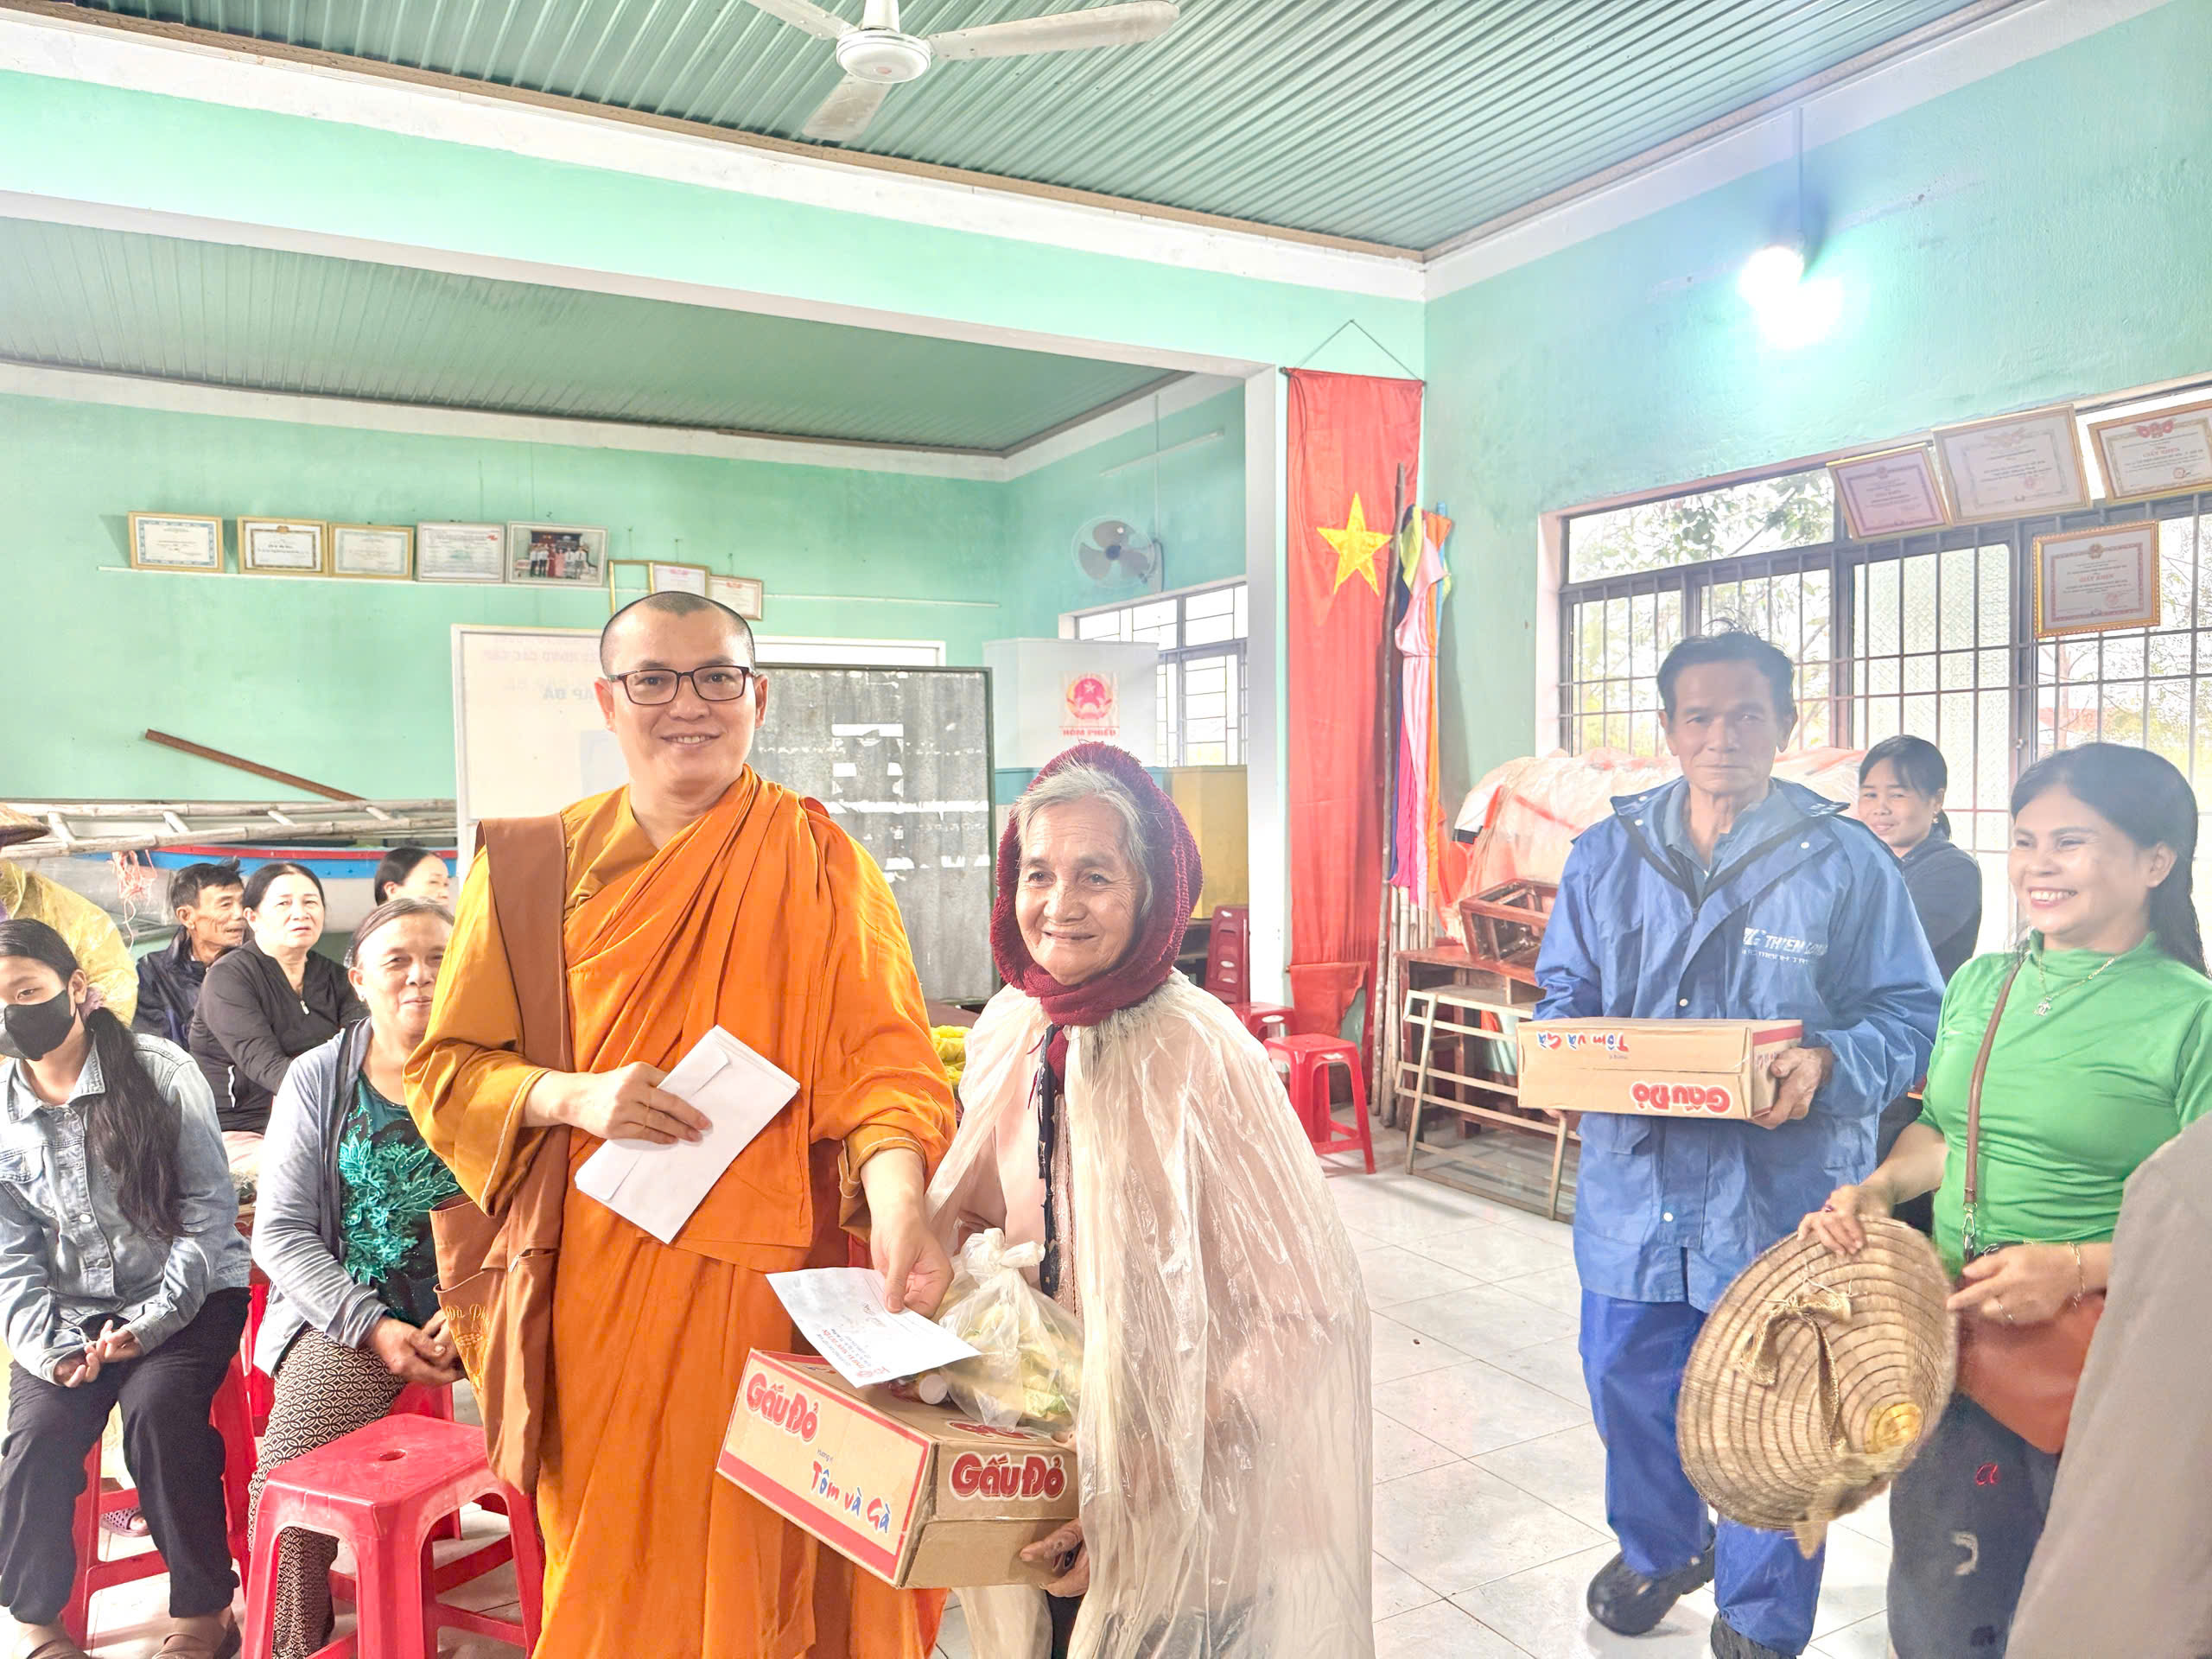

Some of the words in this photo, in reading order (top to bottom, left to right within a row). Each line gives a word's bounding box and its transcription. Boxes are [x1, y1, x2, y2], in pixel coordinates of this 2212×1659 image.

[1538, 1032, 1562, 1050] Gà
[1567, 1033, 1586, 1049] và
[1592, 1033, 1629, 1052] Tôm
[811, 1460, 840, 1501] Tôm
[844, 1486, 862, 1516] và
[867, 1497, 891, 1534] Gà
